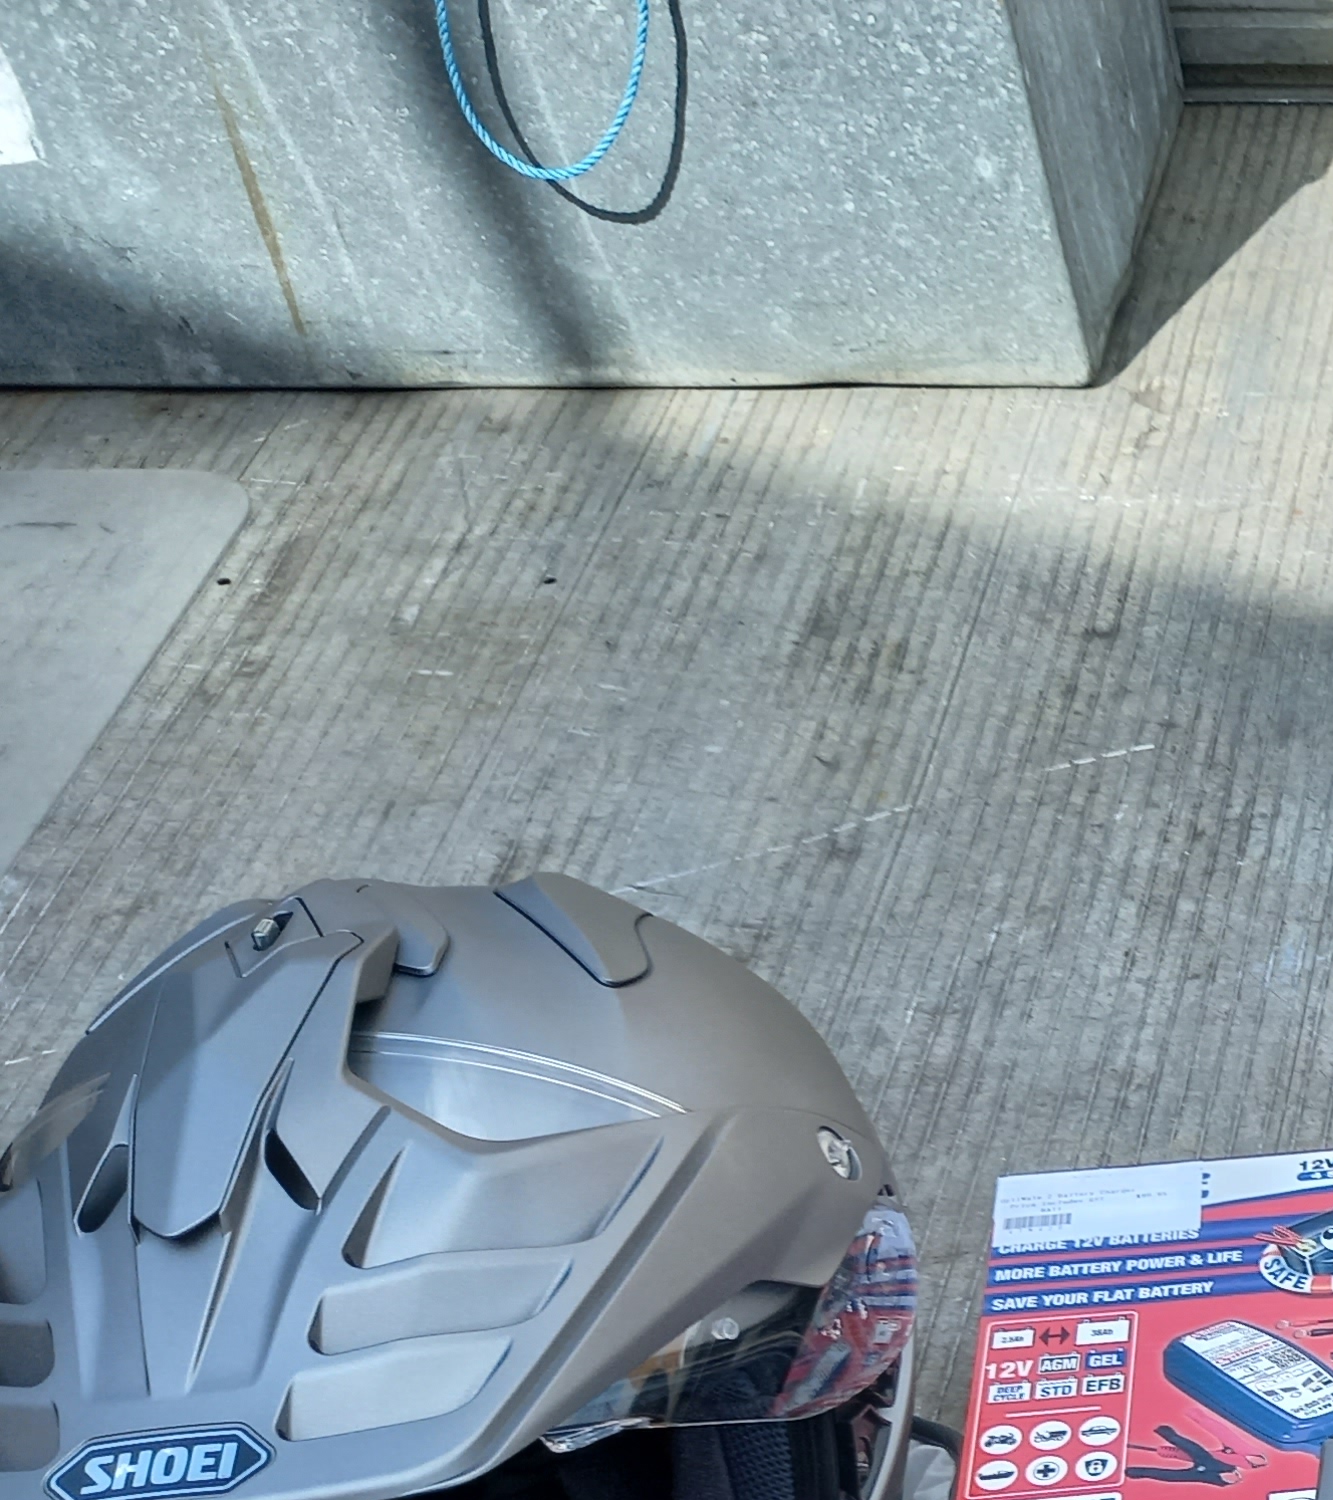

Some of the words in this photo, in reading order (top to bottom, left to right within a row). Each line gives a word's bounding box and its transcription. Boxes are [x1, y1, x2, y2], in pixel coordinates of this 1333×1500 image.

[1074, 1235, 1105, 1249] 12V
[1109, 1228, 1201, 1247] BATTERIES
[995, 1266, 1046, 1282] MORE
[1049, 1260, 1123, 1278] BATTERY
[1125, 1254, 1187, 1271] POWER
[1189, 1253, 1204, 1265] &
[1207, 1250, 1244, 1264] LIFE
[1264, 1257, 1309, 1291] SAFE
[991, 1295, 1039, 1312] SAVE
[1042, 1290, 1090, 1308] YOUR
[1092, 1287, 1135, 1304] FLAT
[1137, 1280, 1215, 1300] BATTERY
[985, 1359, 1034, 1379] 12V
[1040, 1357, 1078, 1372] AGM
[1089, 1354, 1122, 1367] GEL
[997, 1385, 1023, 1394] DEEP
[1040, 1385, 1072, 1397] STD
[1086, 1378, 1121, 1392] EFB
[993, 1393, 1025, 1402] CYCLE
[80, 1442, 238, 1495] SHOEI
